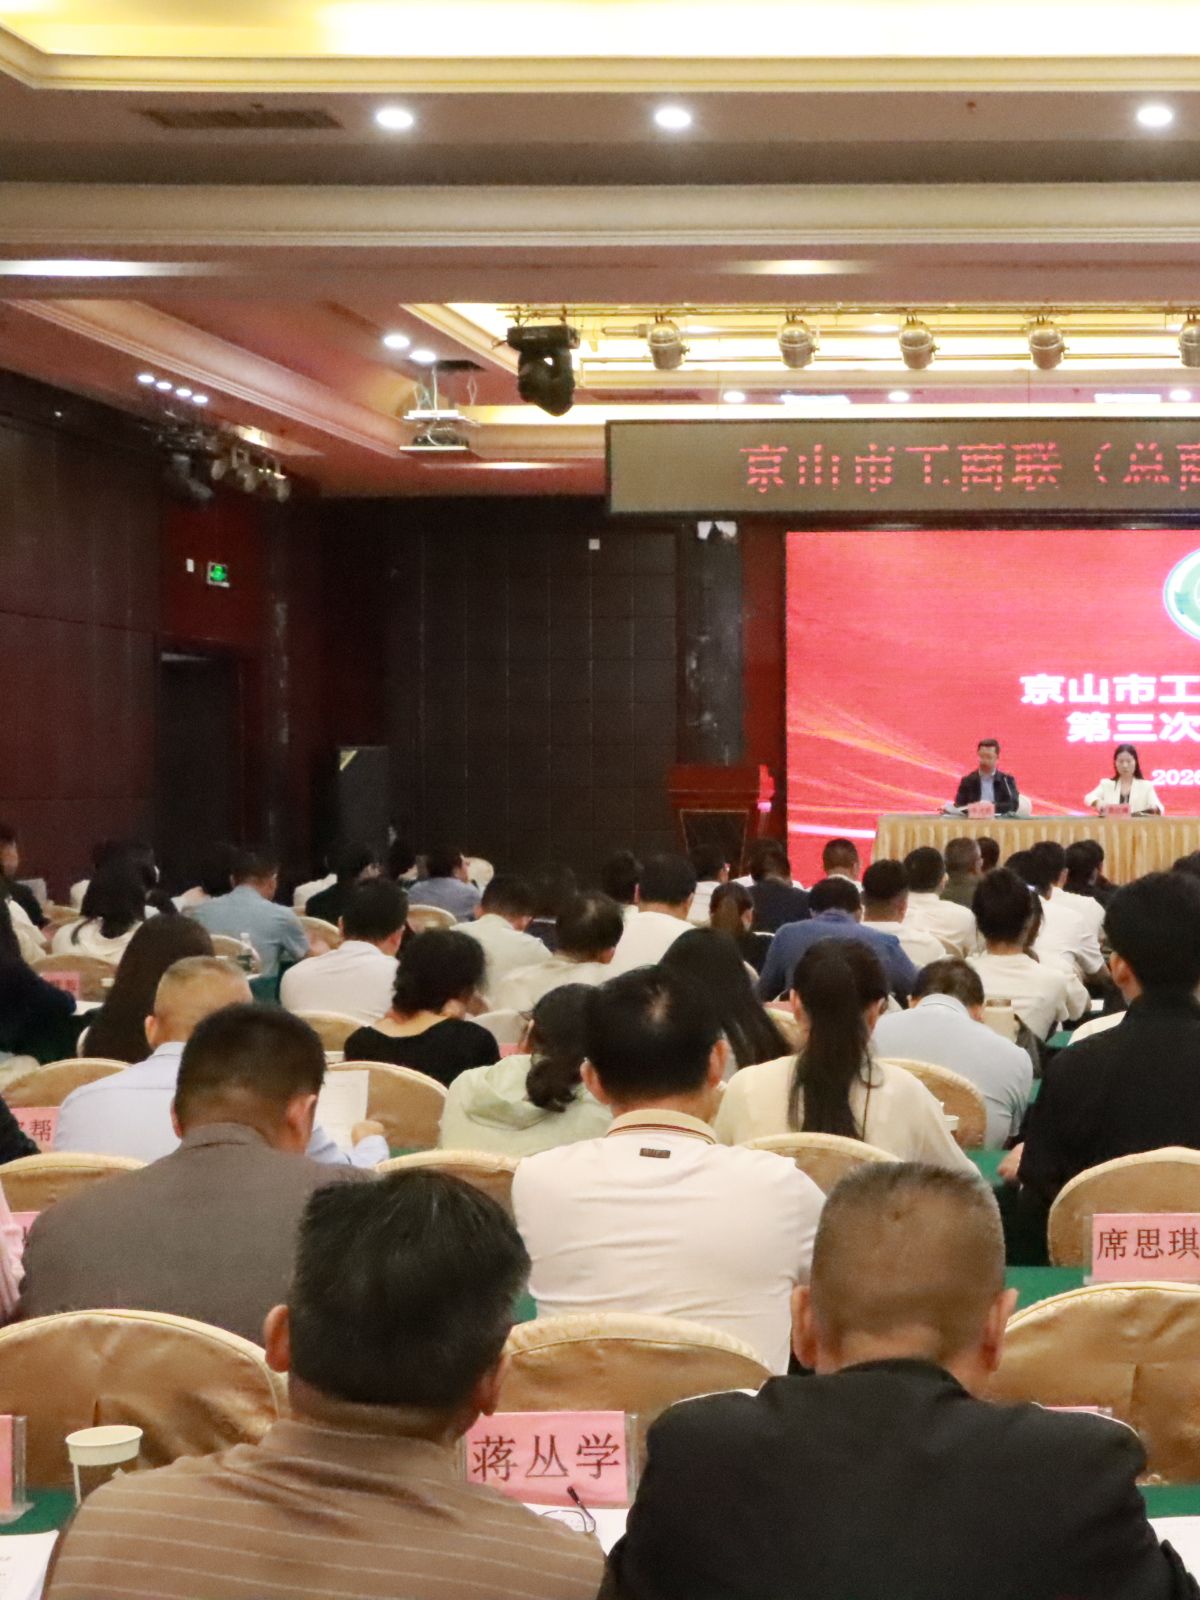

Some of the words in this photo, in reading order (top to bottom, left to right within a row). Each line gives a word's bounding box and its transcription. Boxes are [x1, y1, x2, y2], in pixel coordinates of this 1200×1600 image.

[1096, 1227, 1200, 1261] 席思琪
[471, 1432, 621, 1483] 蒋丛学
